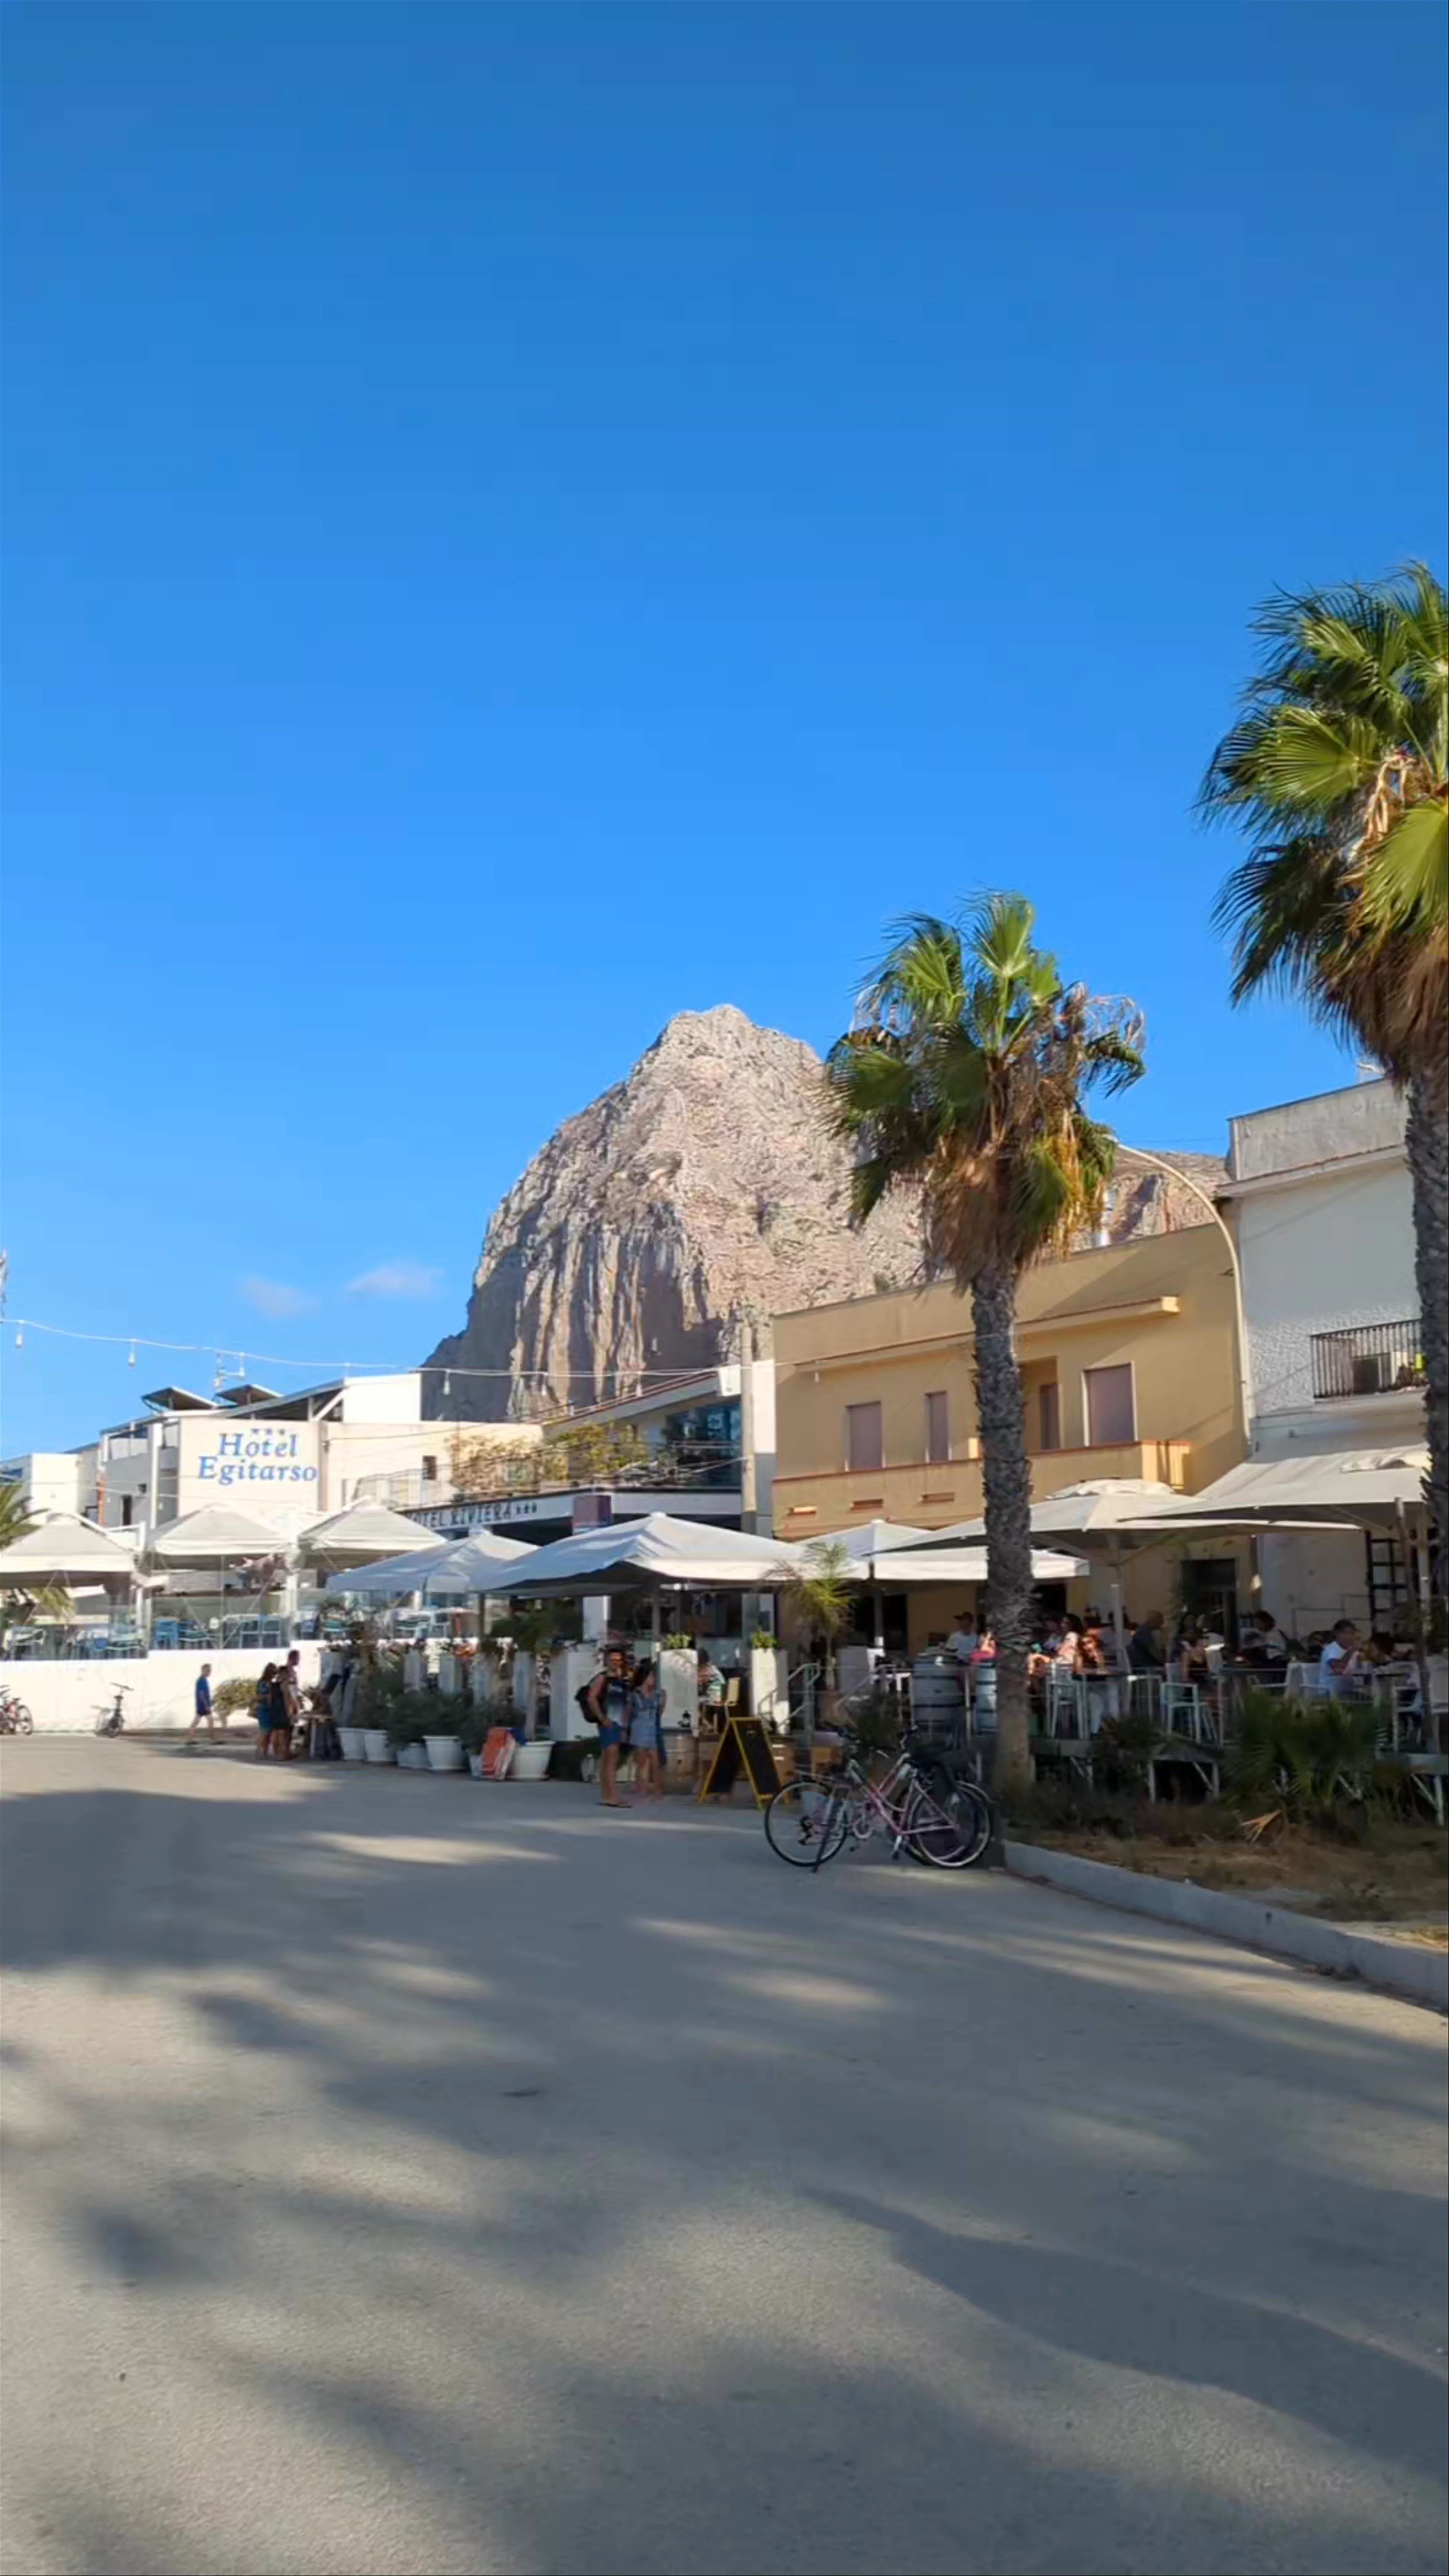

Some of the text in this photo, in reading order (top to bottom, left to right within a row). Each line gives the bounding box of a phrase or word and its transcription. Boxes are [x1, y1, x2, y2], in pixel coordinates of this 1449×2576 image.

[217, 1433, 298, 1457] Hotel
[197, 1456, 317, 1486] Egitarso
[450, 1502, 511, 1526] RIVIERA
